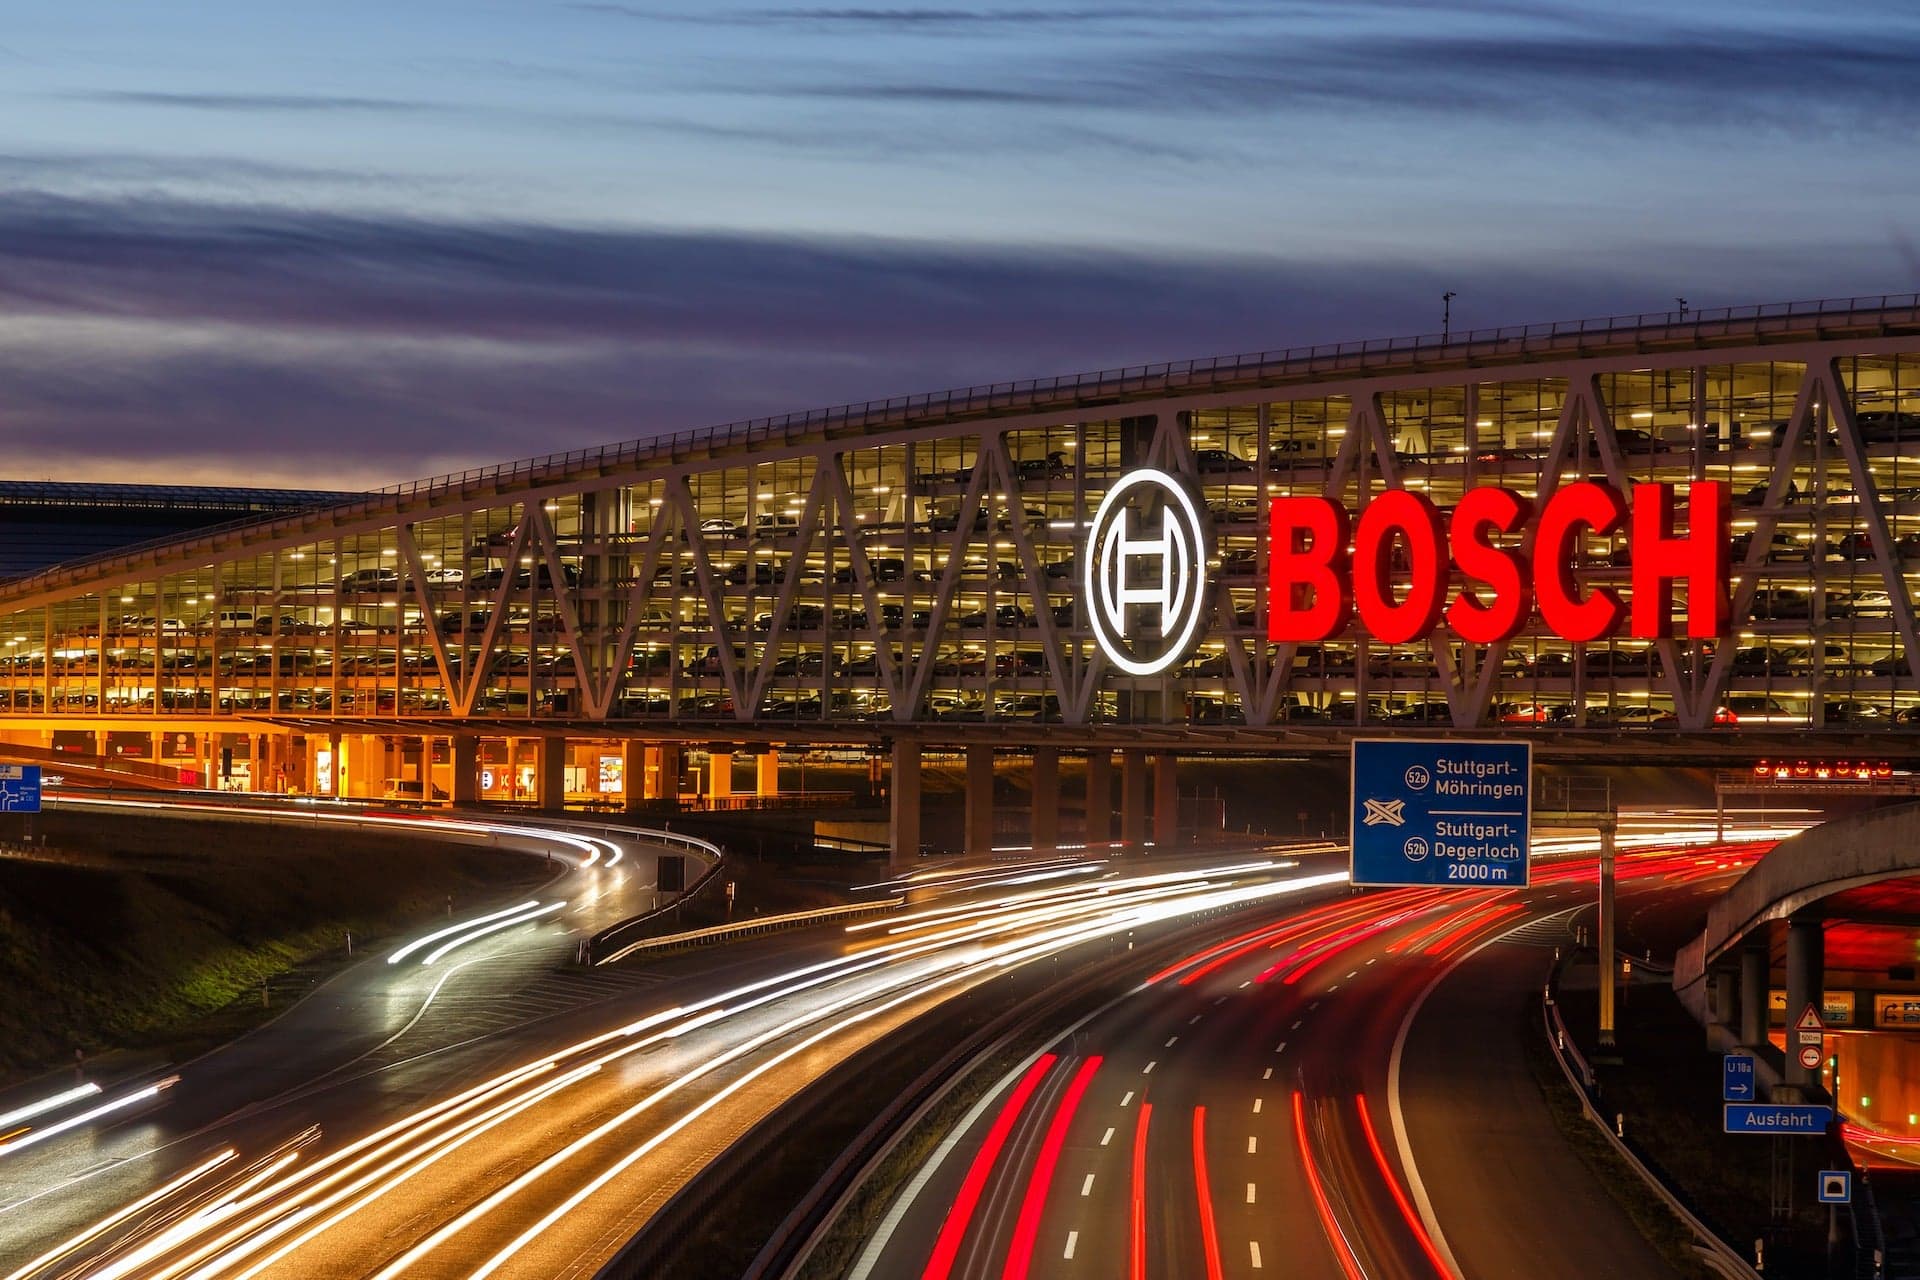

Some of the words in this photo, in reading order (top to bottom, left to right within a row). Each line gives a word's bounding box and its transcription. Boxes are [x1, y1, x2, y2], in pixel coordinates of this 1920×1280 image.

[1267, 480, 1728, 644] BOSCH
[1408, 772, 1427, 784] 52a
[1436, 759, 1518, 778] Stuttgart-
[1435, 780, 1524, 799] Möhringen
[1435, 821, 1517, 840] Stuttgart-
[1407, 843, 1426, 855] 52b
[1434, 842, 1519, 861] Degerloch
[1448, 863, 1488, 879] 2000
[1491, 867, 1507, 880] m
[1744, 1111, 1813, 1127] Ausfahrt
